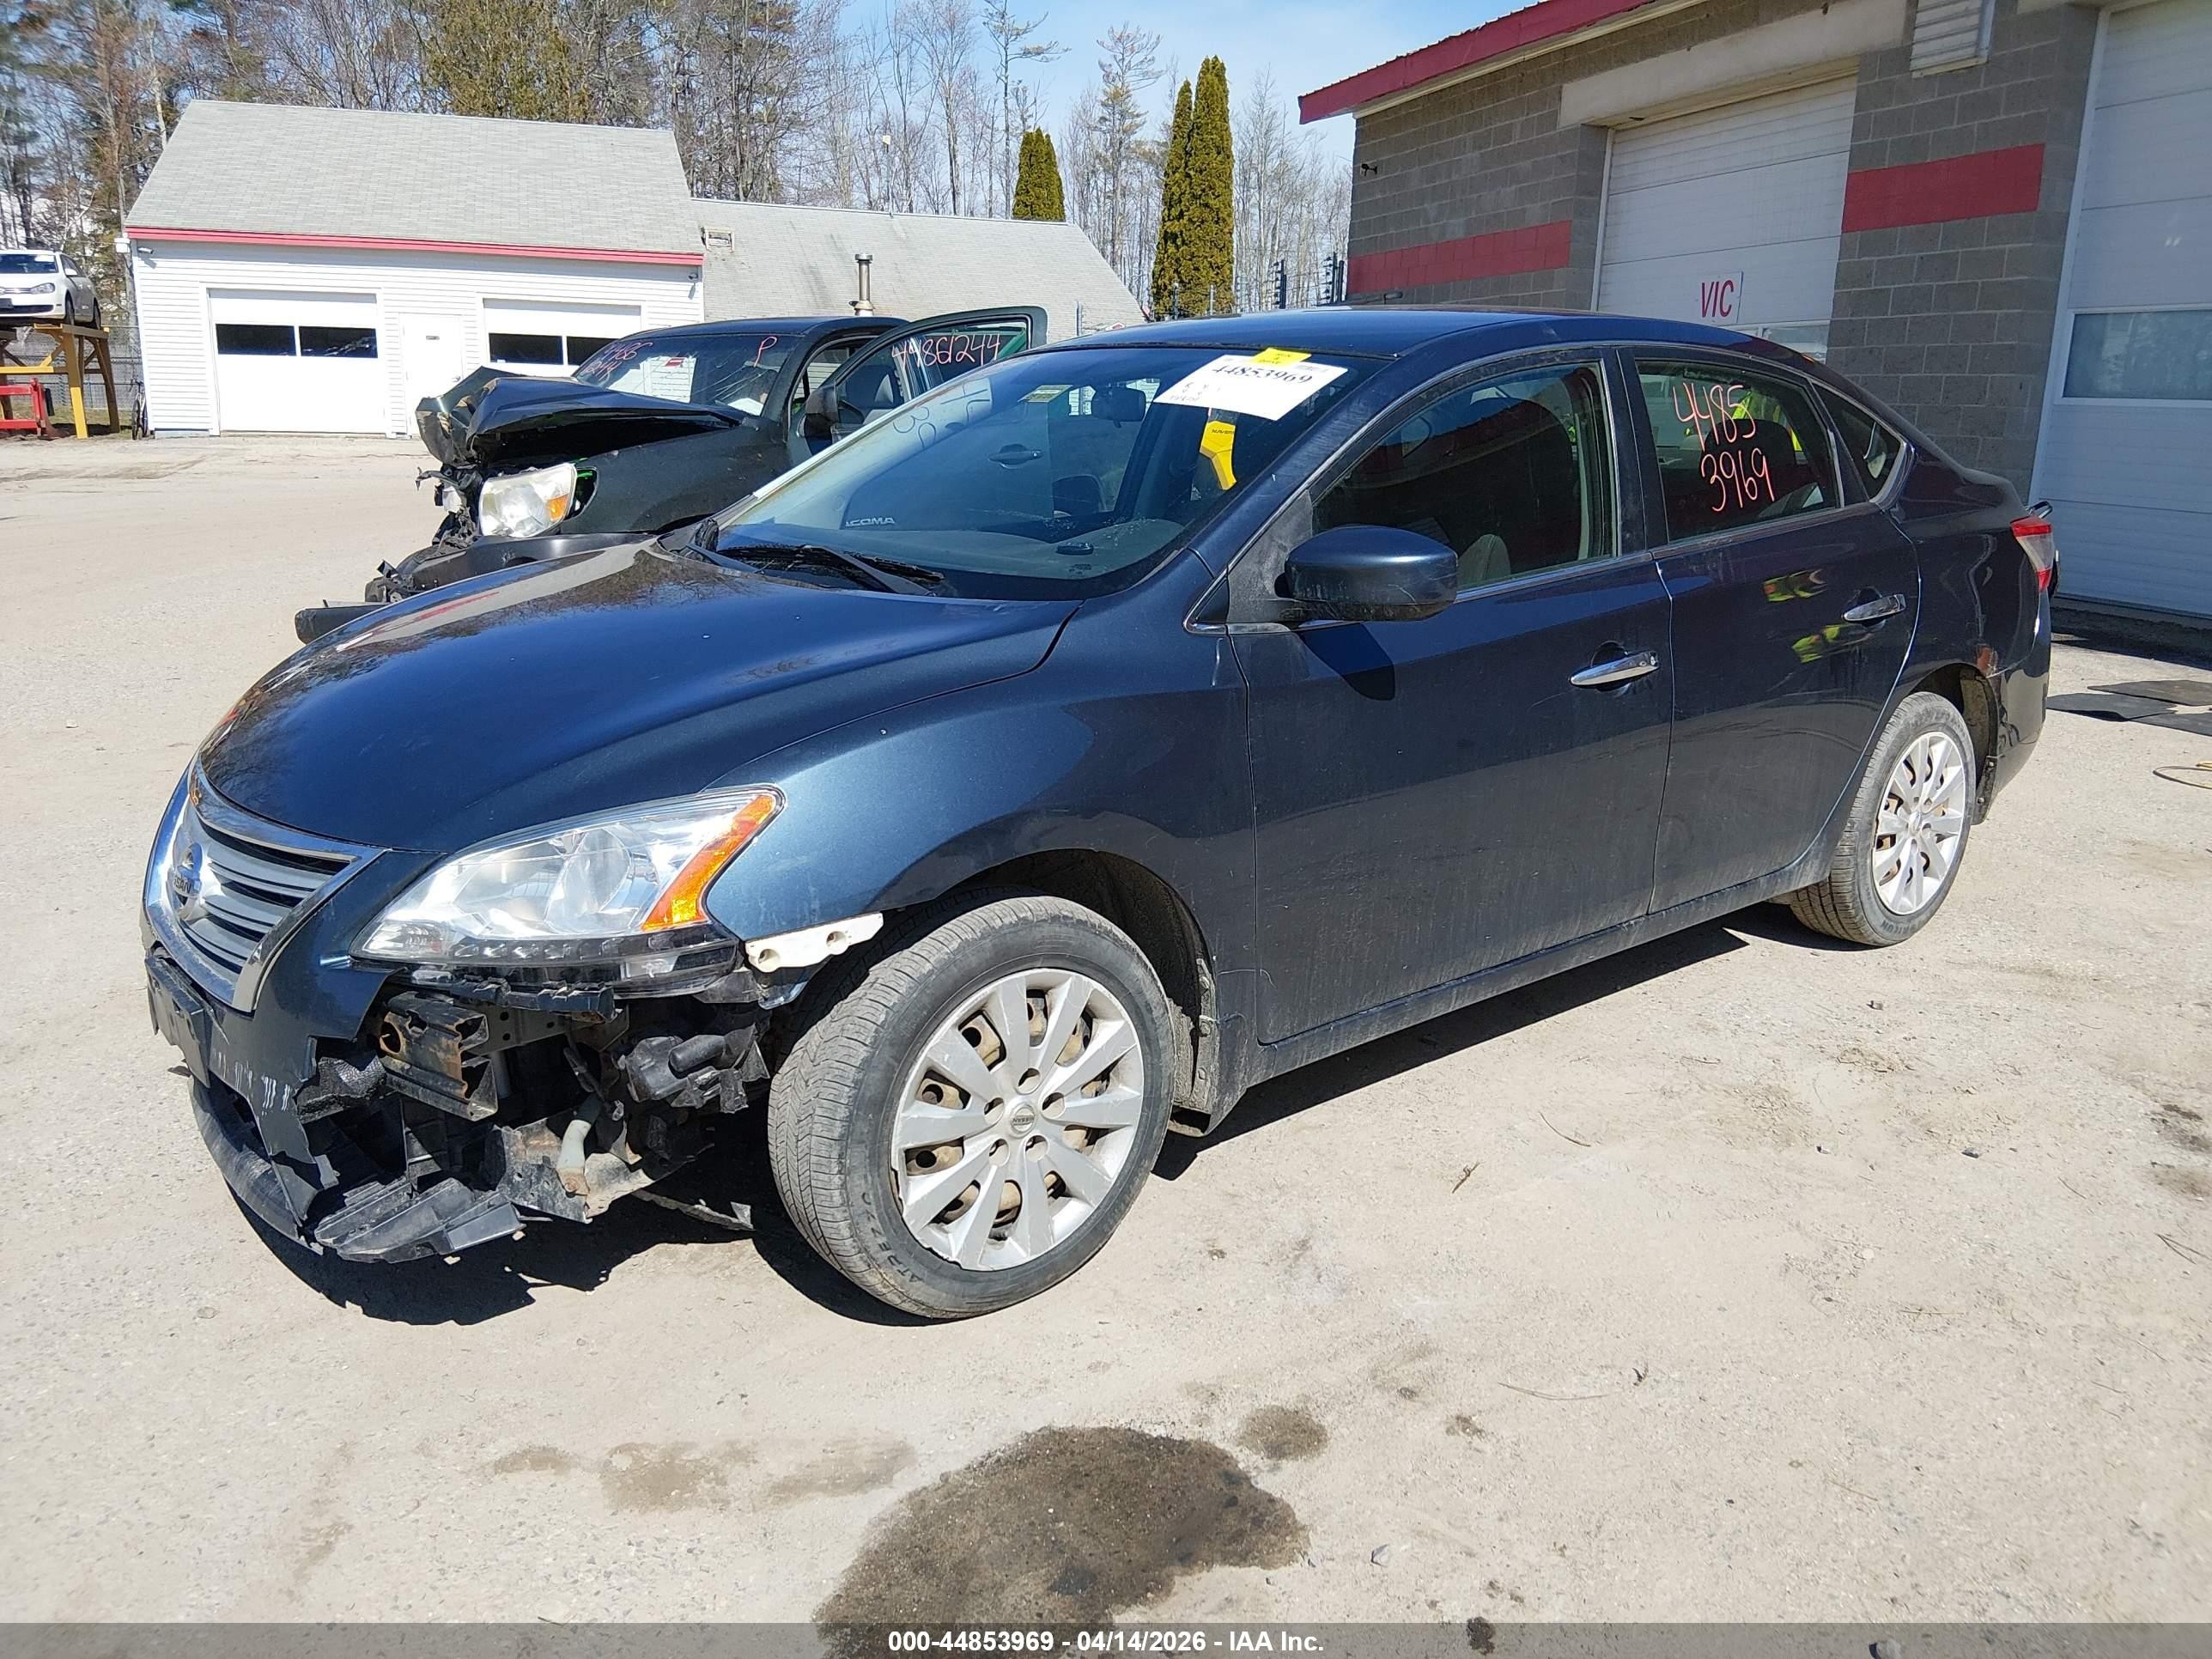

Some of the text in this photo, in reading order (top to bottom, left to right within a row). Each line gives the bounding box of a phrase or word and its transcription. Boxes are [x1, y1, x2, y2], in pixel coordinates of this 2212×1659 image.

[1701, 279, 1735, 318] VIC
[753, 336, 778, 368] P
[891, 333, 1000, 370] 44861244
[1212, 364, 1312, 385] 44853969
[1673, 382, 1756, 452] 4485
[1701, 447, 1775, 514] 3969
